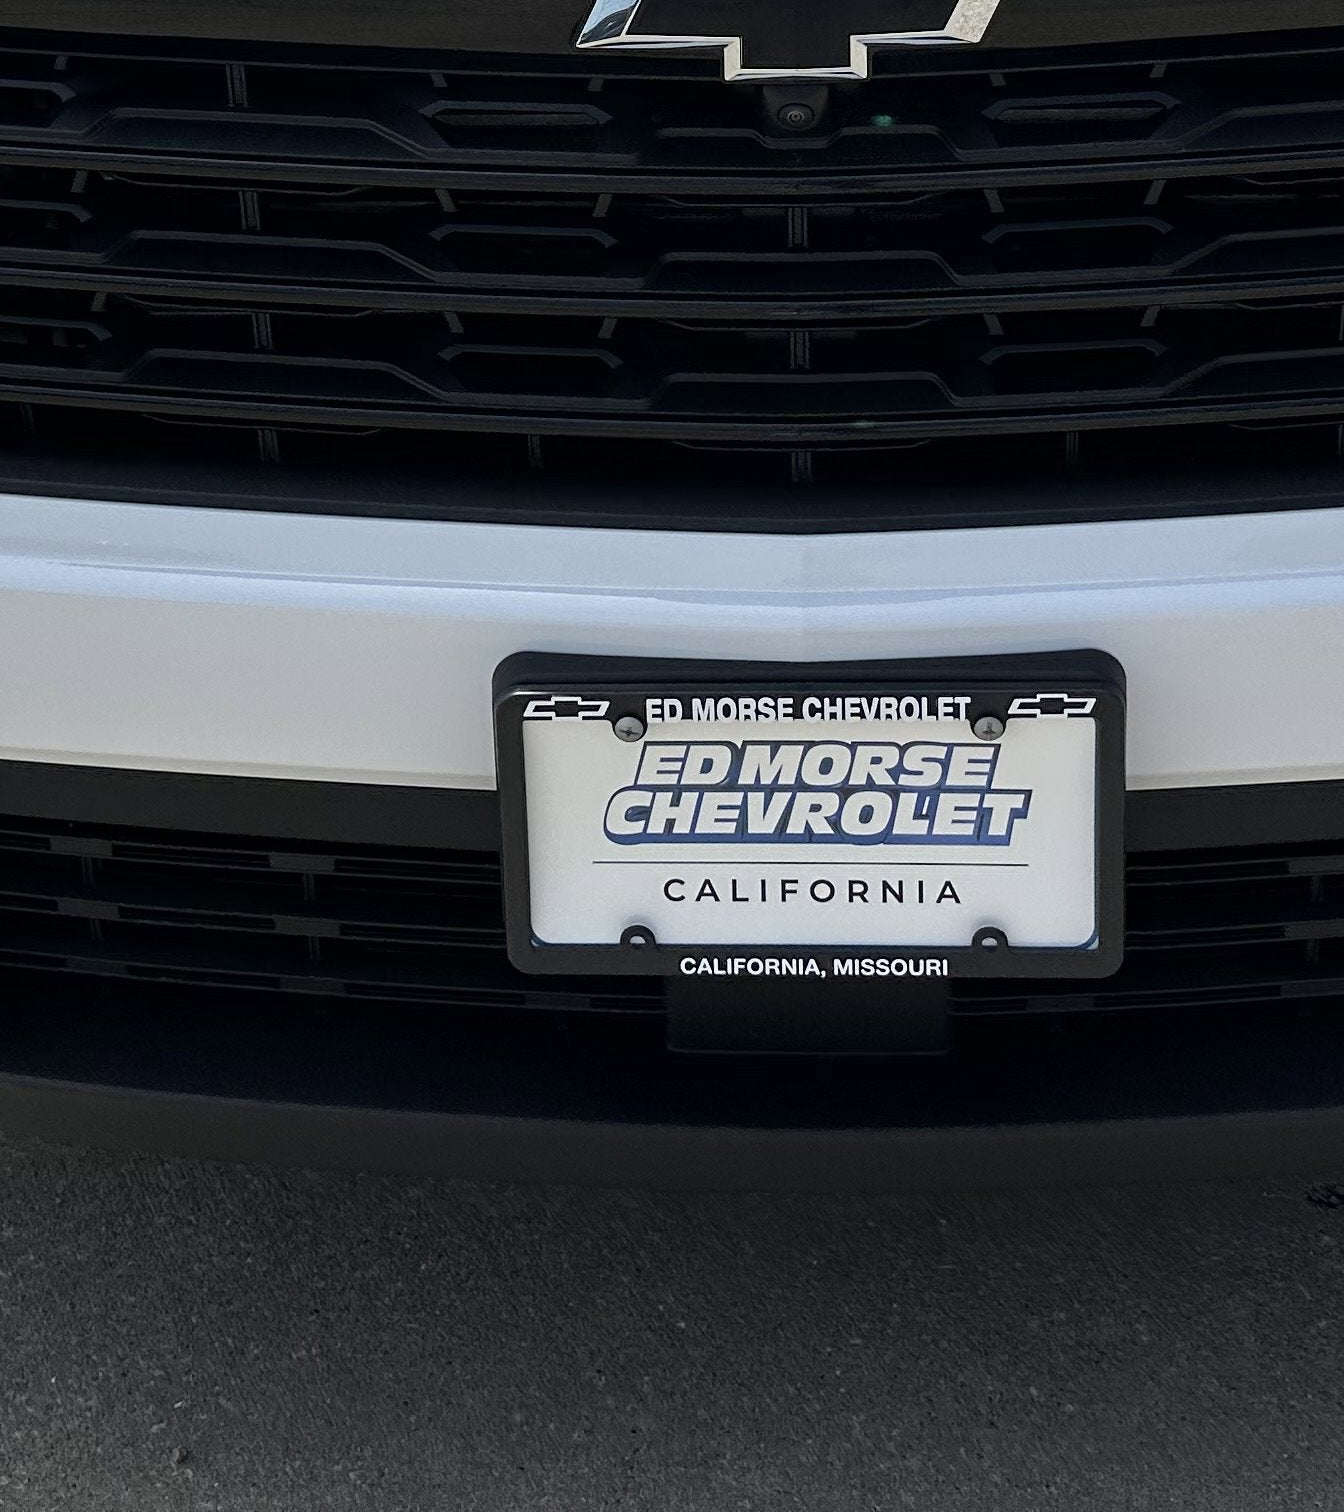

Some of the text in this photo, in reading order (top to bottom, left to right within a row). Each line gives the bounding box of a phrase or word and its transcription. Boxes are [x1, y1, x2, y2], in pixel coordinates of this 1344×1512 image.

[645, 696, 972, 723] ED MORSE CHEVROLET
[635, 742, 1001, 787] ED MORSE
[603, 788, 1032, 845] CHEVROLET
[663, 878, 962, 904] CALIFORNIA
[679, 957, 949, 978] CALIFORNIA, MISSOURI
